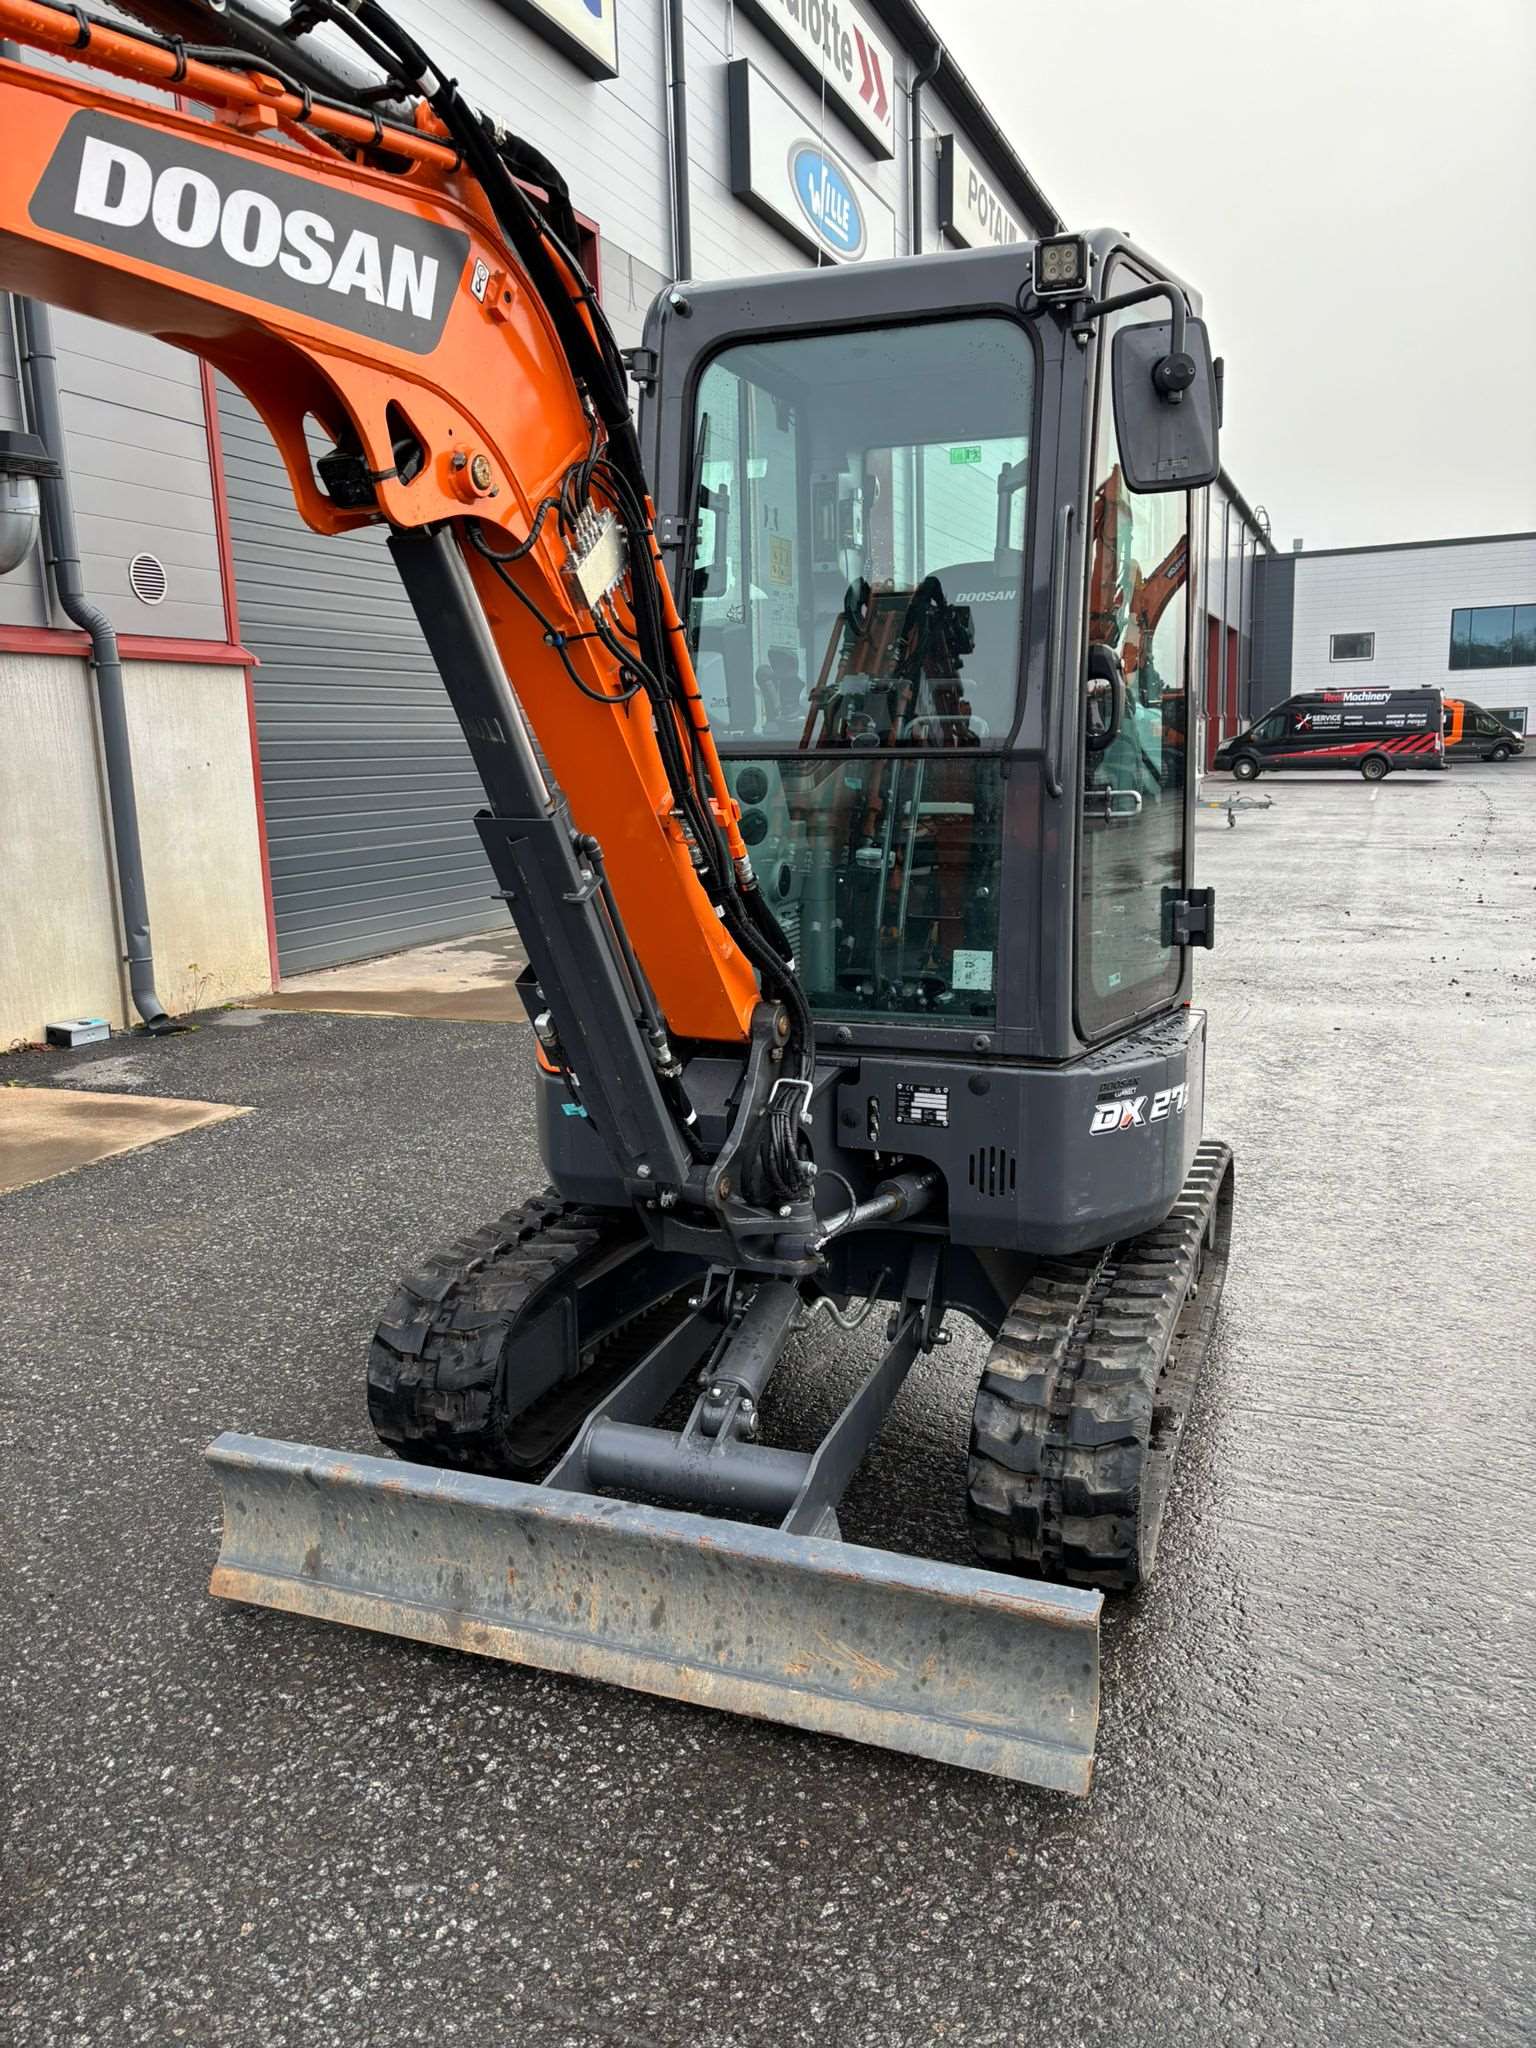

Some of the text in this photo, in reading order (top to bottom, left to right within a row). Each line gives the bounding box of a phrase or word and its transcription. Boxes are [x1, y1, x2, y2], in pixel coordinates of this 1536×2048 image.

[74, 135, 439, 321] DOOSAN
[956, 590, 1016, 602] DOOSAN
[1089, 1096, 1148, 1136] DX
